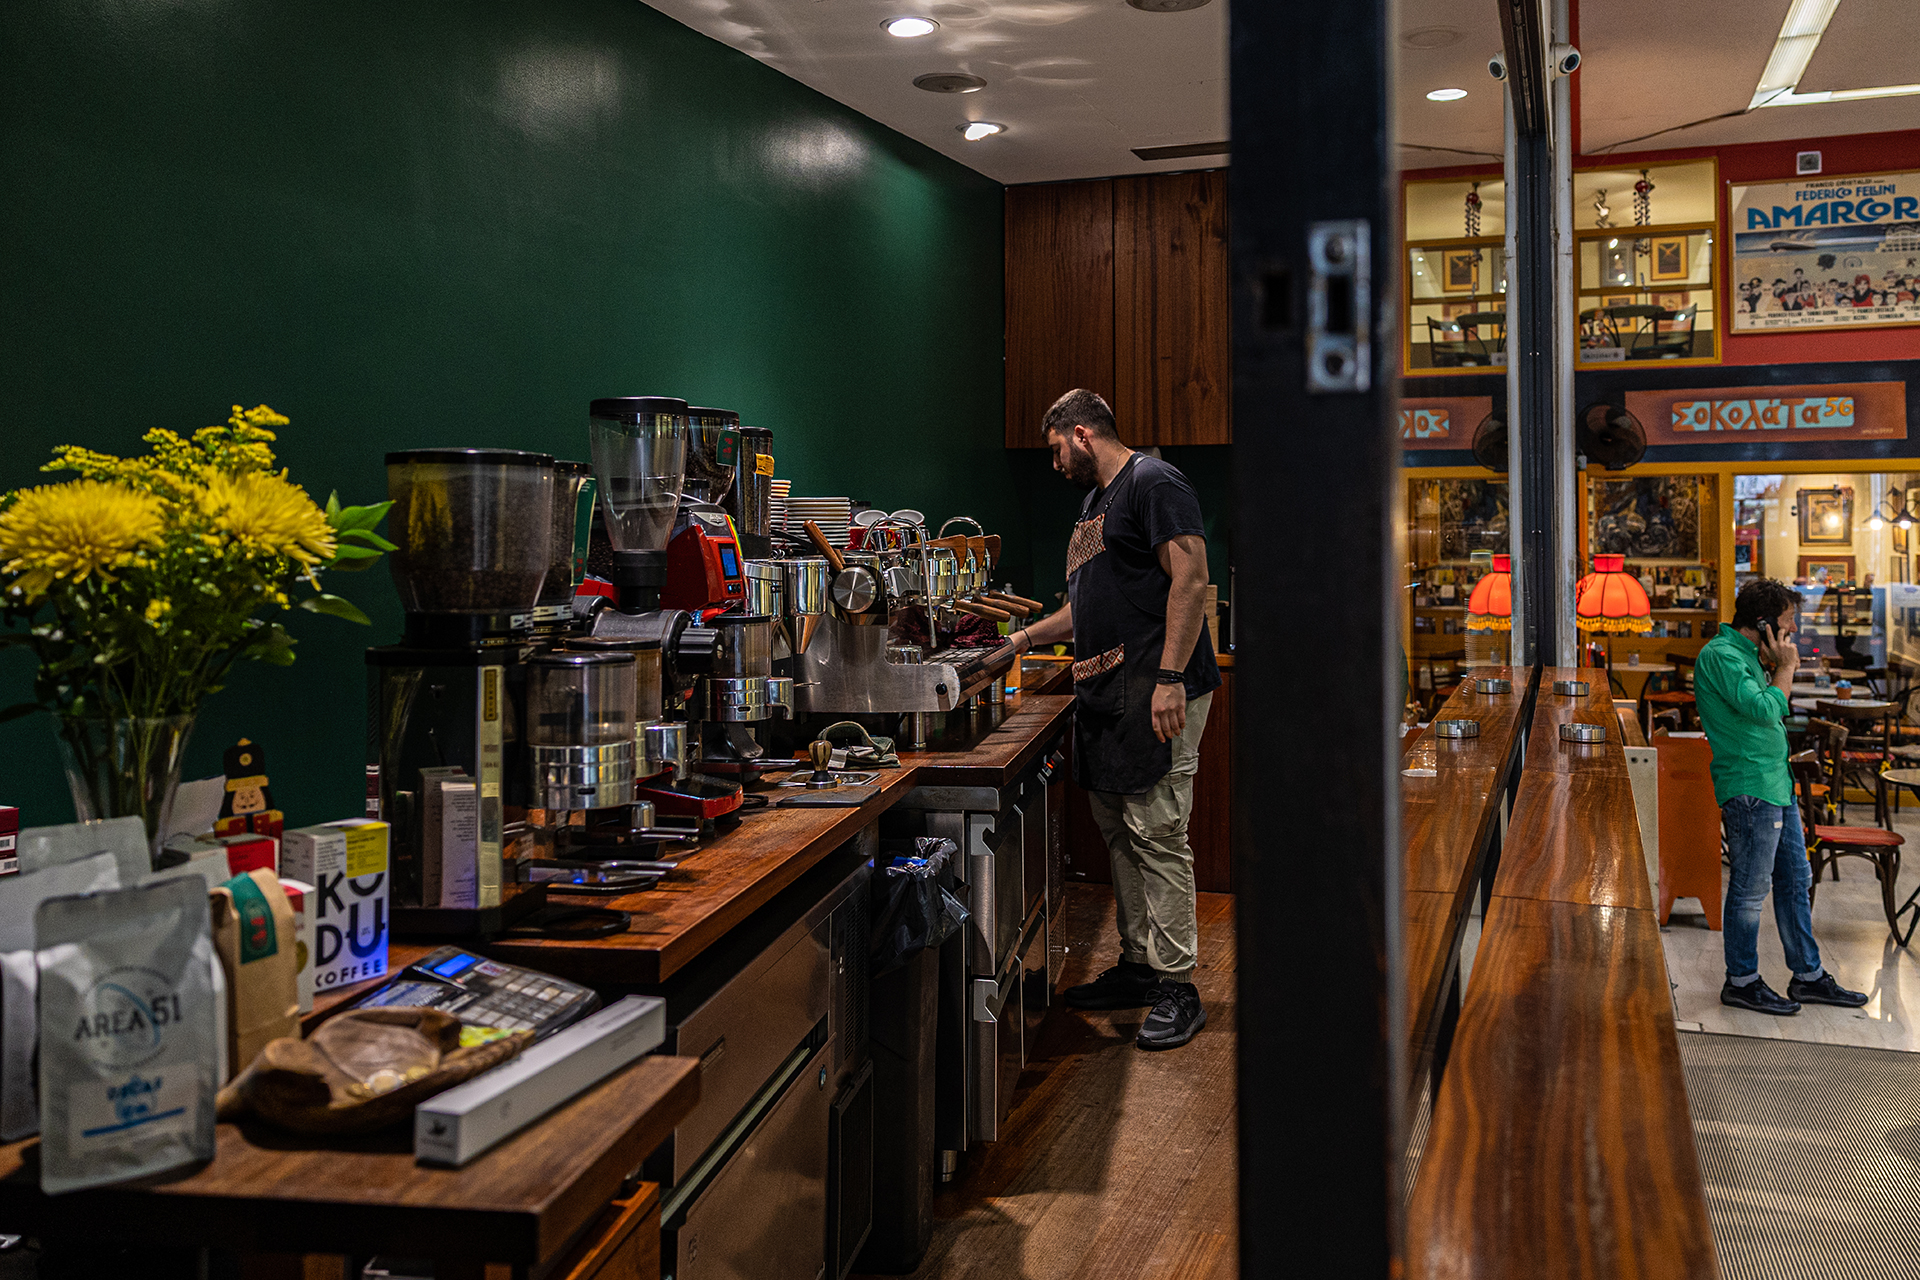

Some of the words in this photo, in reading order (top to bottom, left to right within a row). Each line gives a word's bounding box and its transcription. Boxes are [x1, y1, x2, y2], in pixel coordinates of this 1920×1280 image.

[1796, 187, 1853, 201] FEDERICO
[1856, 184, 1896, 197] FELLINI
[1747, 196, 1920, 230] AMARCOR
[315, 959, 382, 988] COFFEE
[74, 1008, 146, 1041] AREA
[151, 992, 183, 1027] 51
